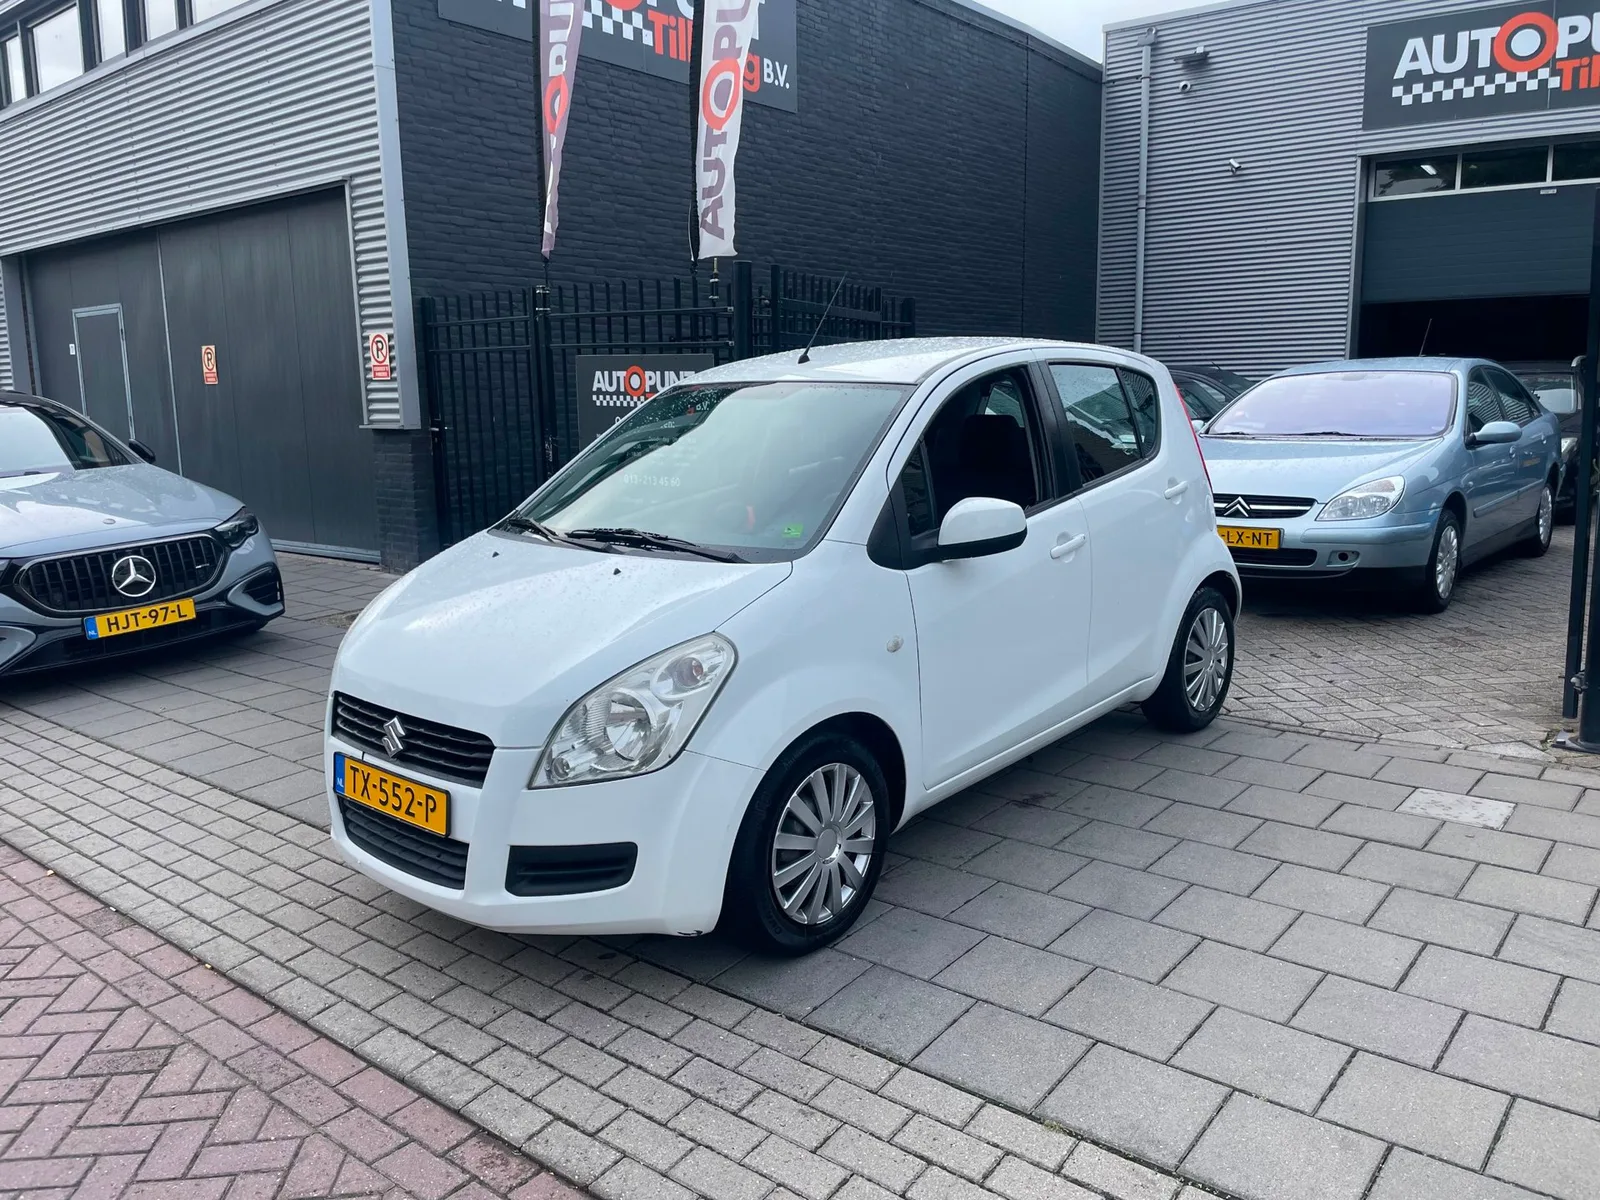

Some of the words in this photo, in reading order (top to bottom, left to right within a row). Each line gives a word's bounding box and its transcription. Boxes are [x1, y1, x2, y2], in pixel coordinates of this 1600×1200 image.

[1393, 11, 1600, 80] AUTOP
[763, 58, 790, 90] B.V.
[106, 604, 188, 633] HJT-97-L
[336, 777, 344, 788] NL
[350, 766, 437, 823] TX-552-P
